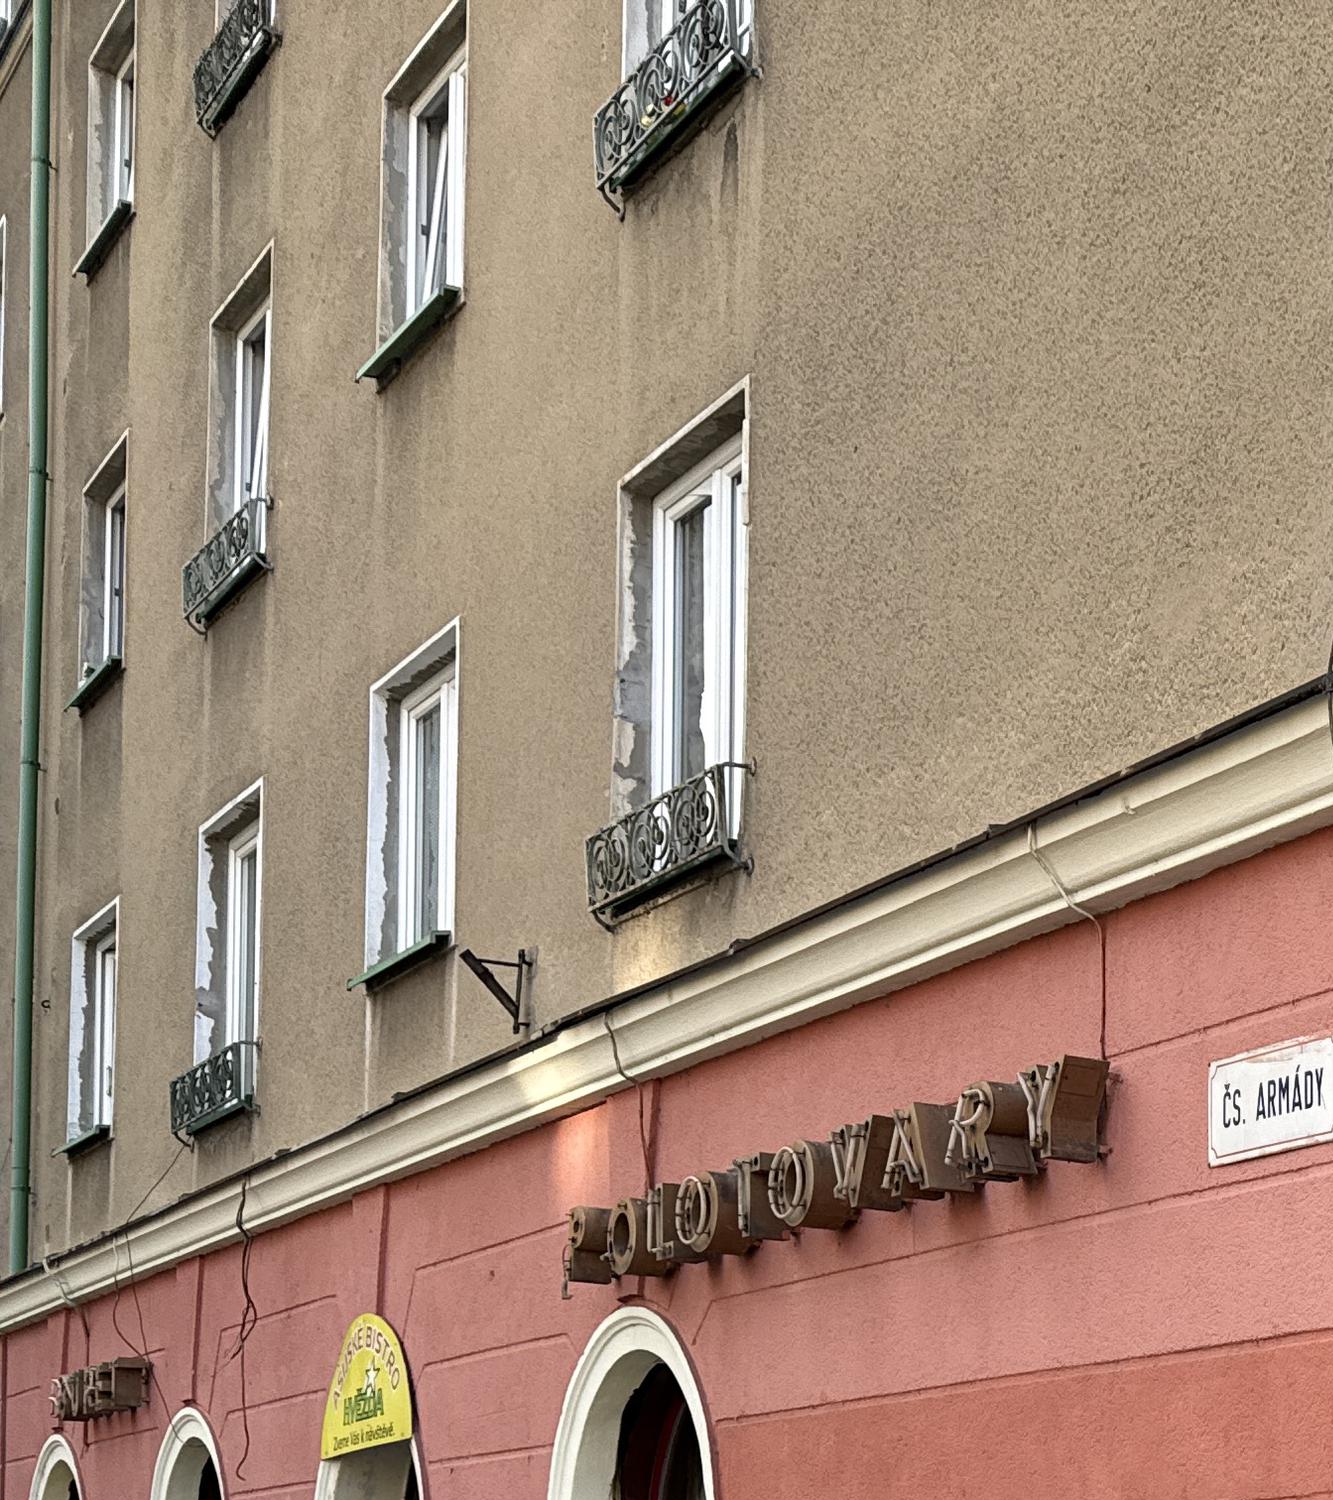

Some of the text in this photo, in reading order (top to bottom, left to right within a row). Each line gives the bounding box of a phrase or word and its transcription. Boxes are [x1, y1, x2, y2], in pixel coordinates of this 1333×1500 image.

[1222, 1063, 1324, 1129] ČS. ARMÁDY
[562, 1053, 1110, 1288] POLOTOVARY
[365, 1325, 401, 1391] BISTRO
[342, 1386, 385, 1427] HVĚZDA
